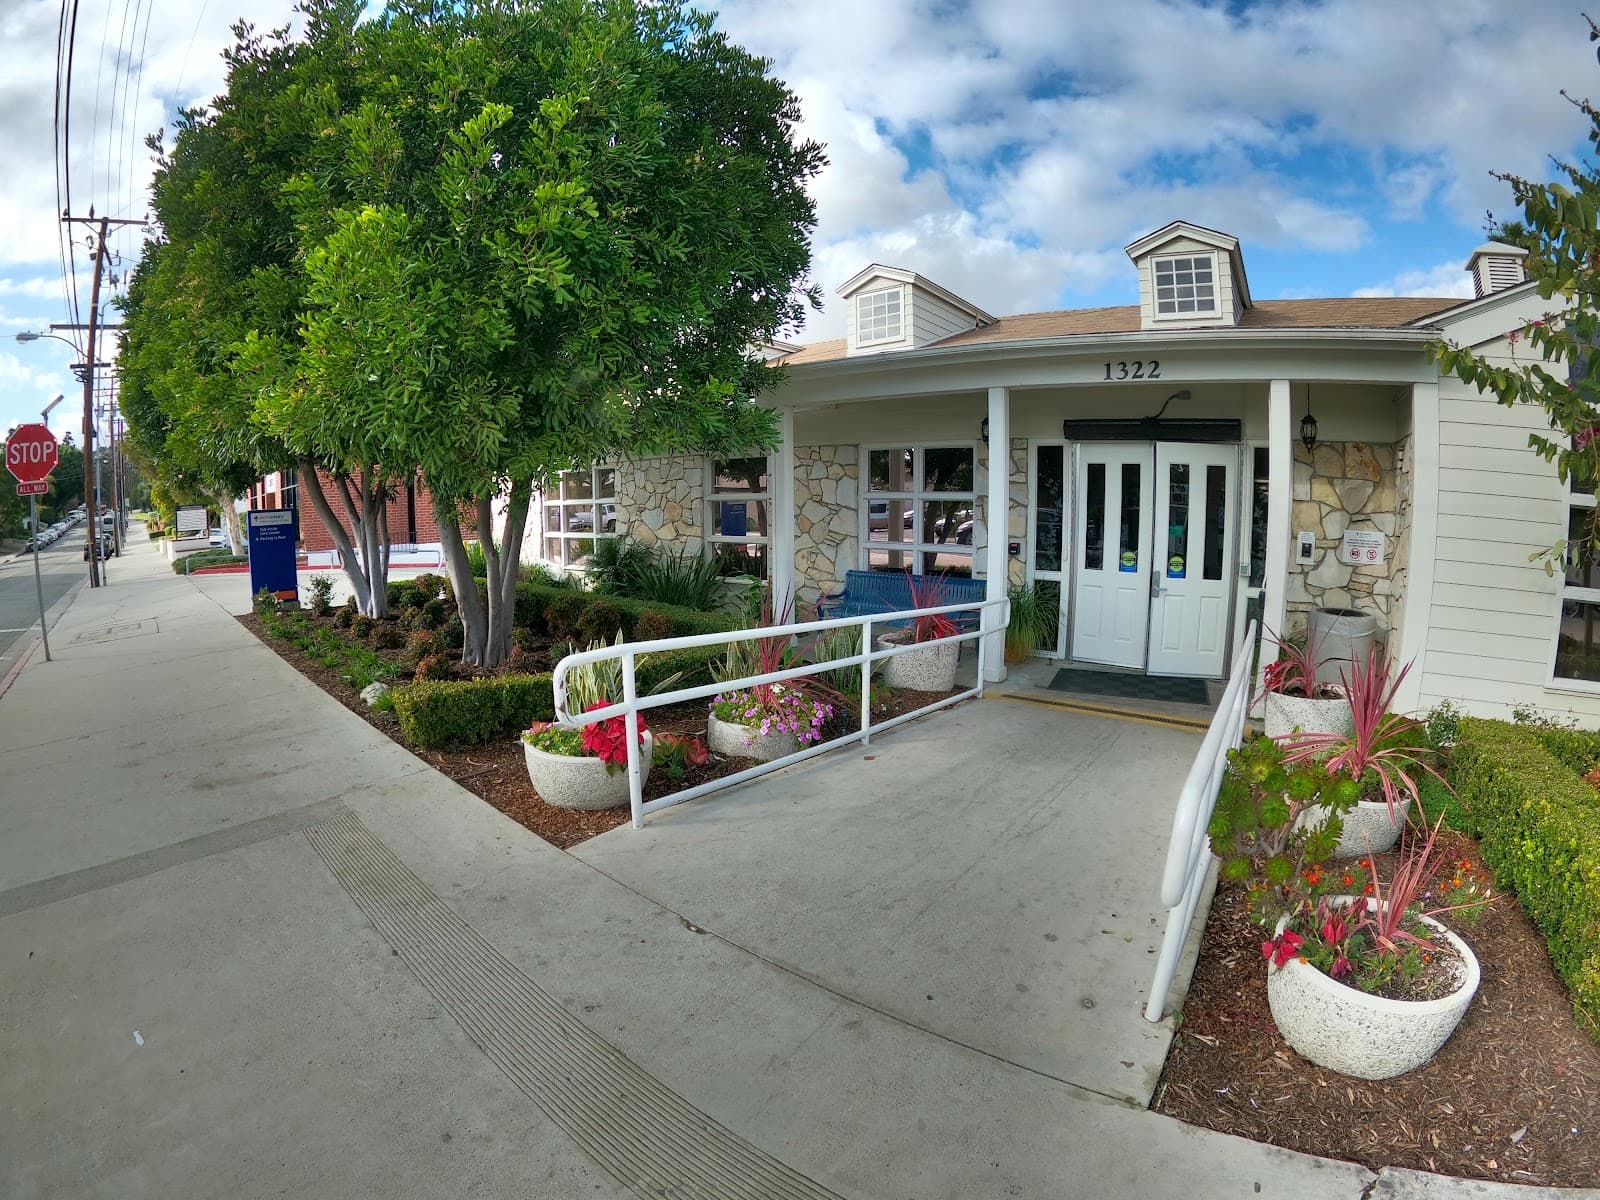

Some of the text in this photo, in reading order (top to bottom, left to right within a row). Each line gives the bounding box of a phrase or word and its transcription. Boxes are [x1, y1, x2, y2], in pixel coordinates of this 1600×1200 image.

[1103, 360, 1161, 380] 1322
[10, 441, 54, 464] STOP
[19, 484, 46, 493] ALL WAY
